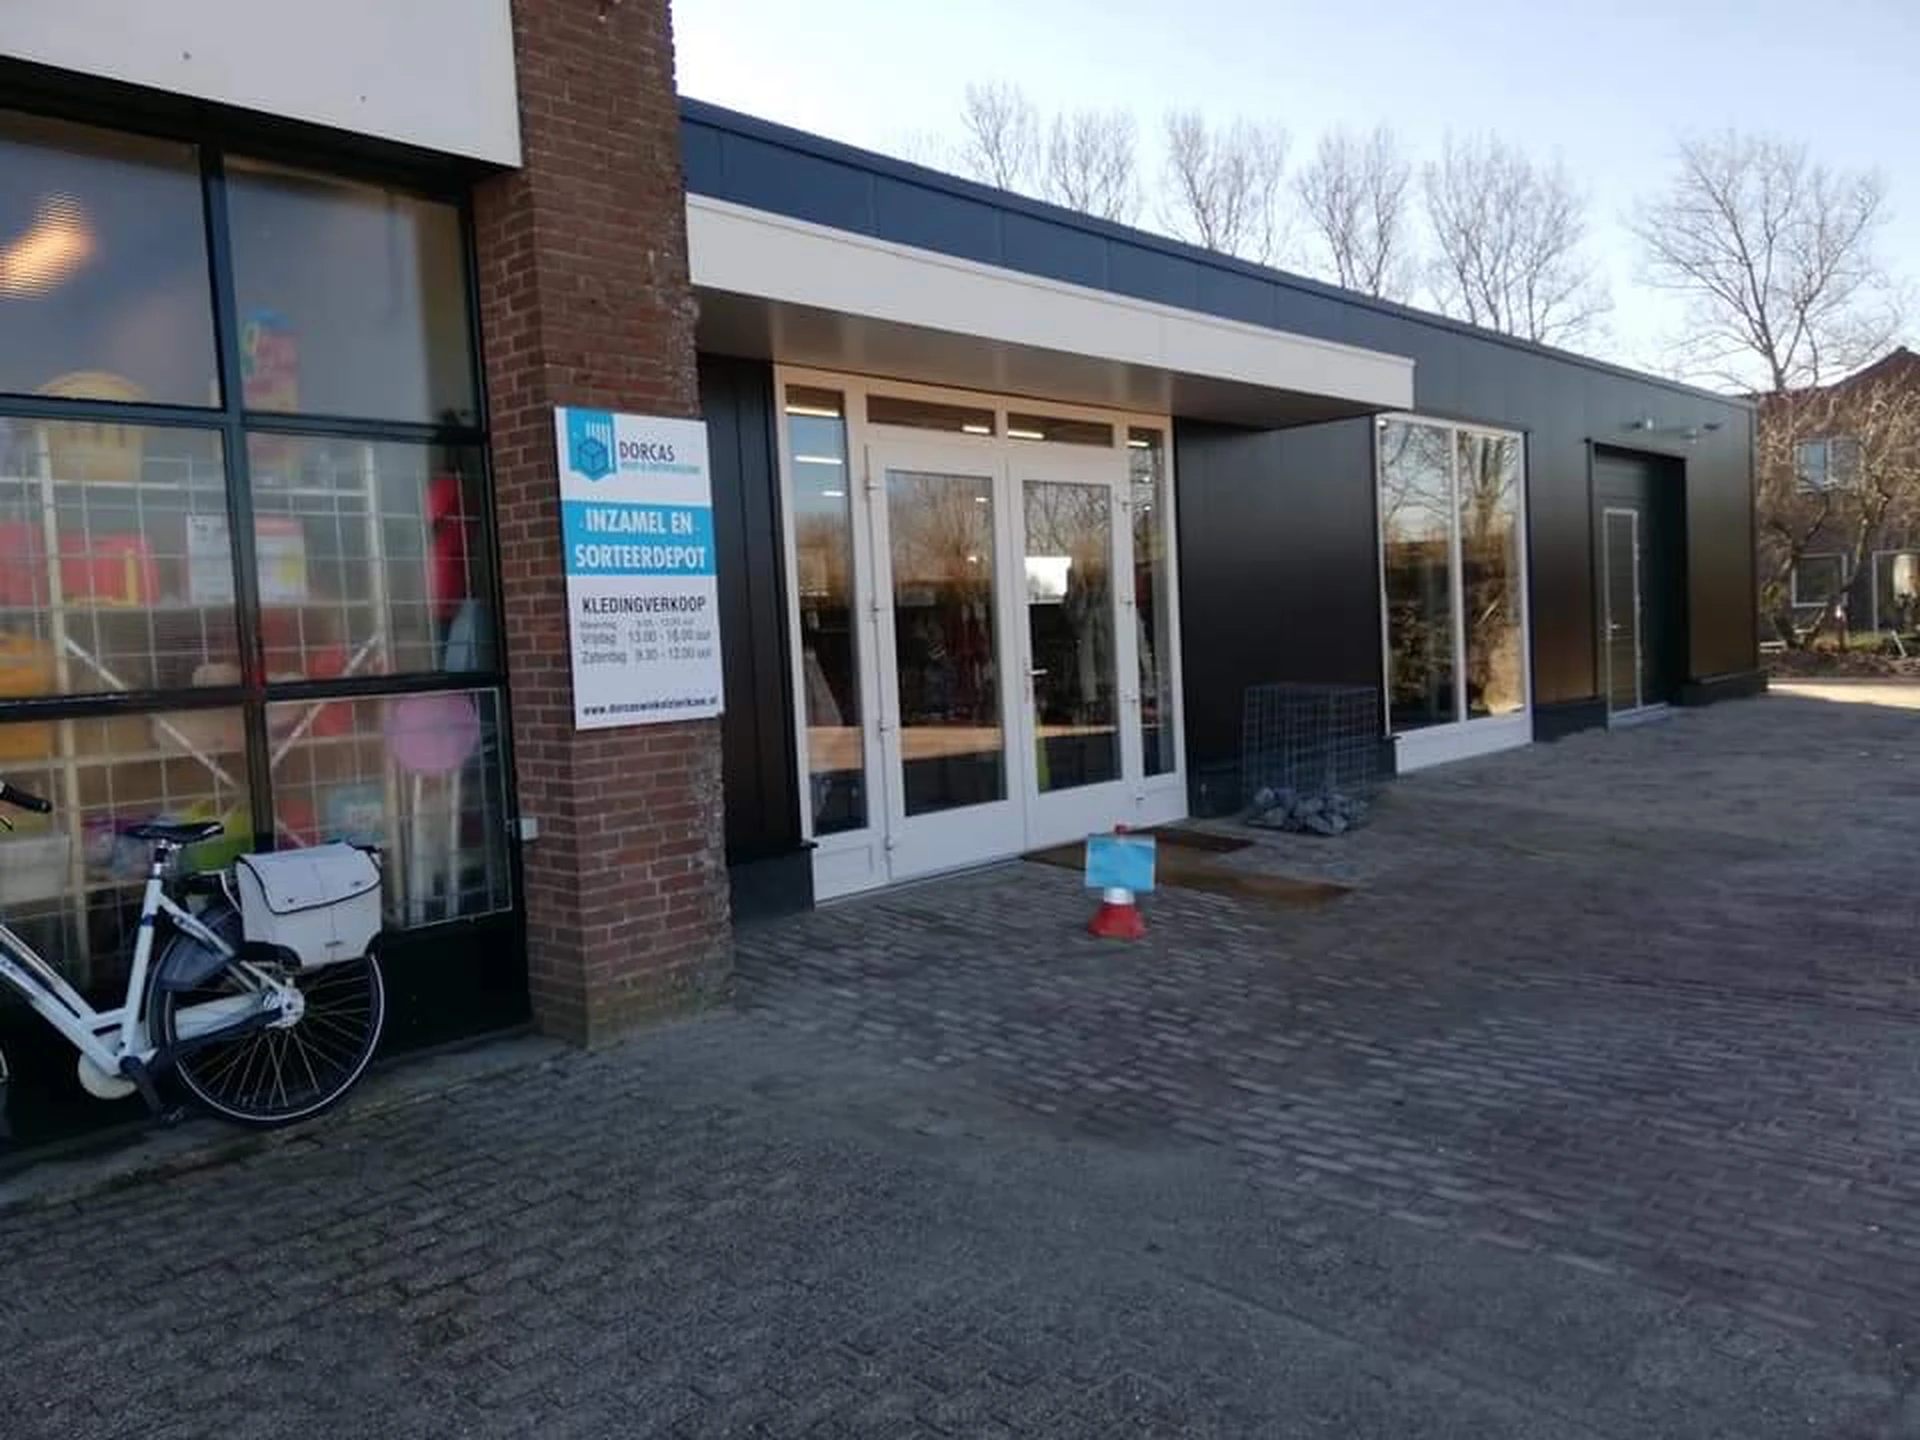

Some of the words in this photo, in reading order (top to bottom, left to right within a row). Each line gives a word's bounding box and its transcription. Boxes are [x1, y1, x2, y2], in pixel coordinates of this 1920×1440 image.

[619, 441, 676, 463] DORCAS
[585, 508, 667, 535] INZAMEL
[670, 511, 693, 535] EN
[574, 543, 706, 569] SORTEERDEPOT
[582, 595, 706, 614] KLEDINGVERKOOP
[580, 650, 627, 665] Zaterdag
